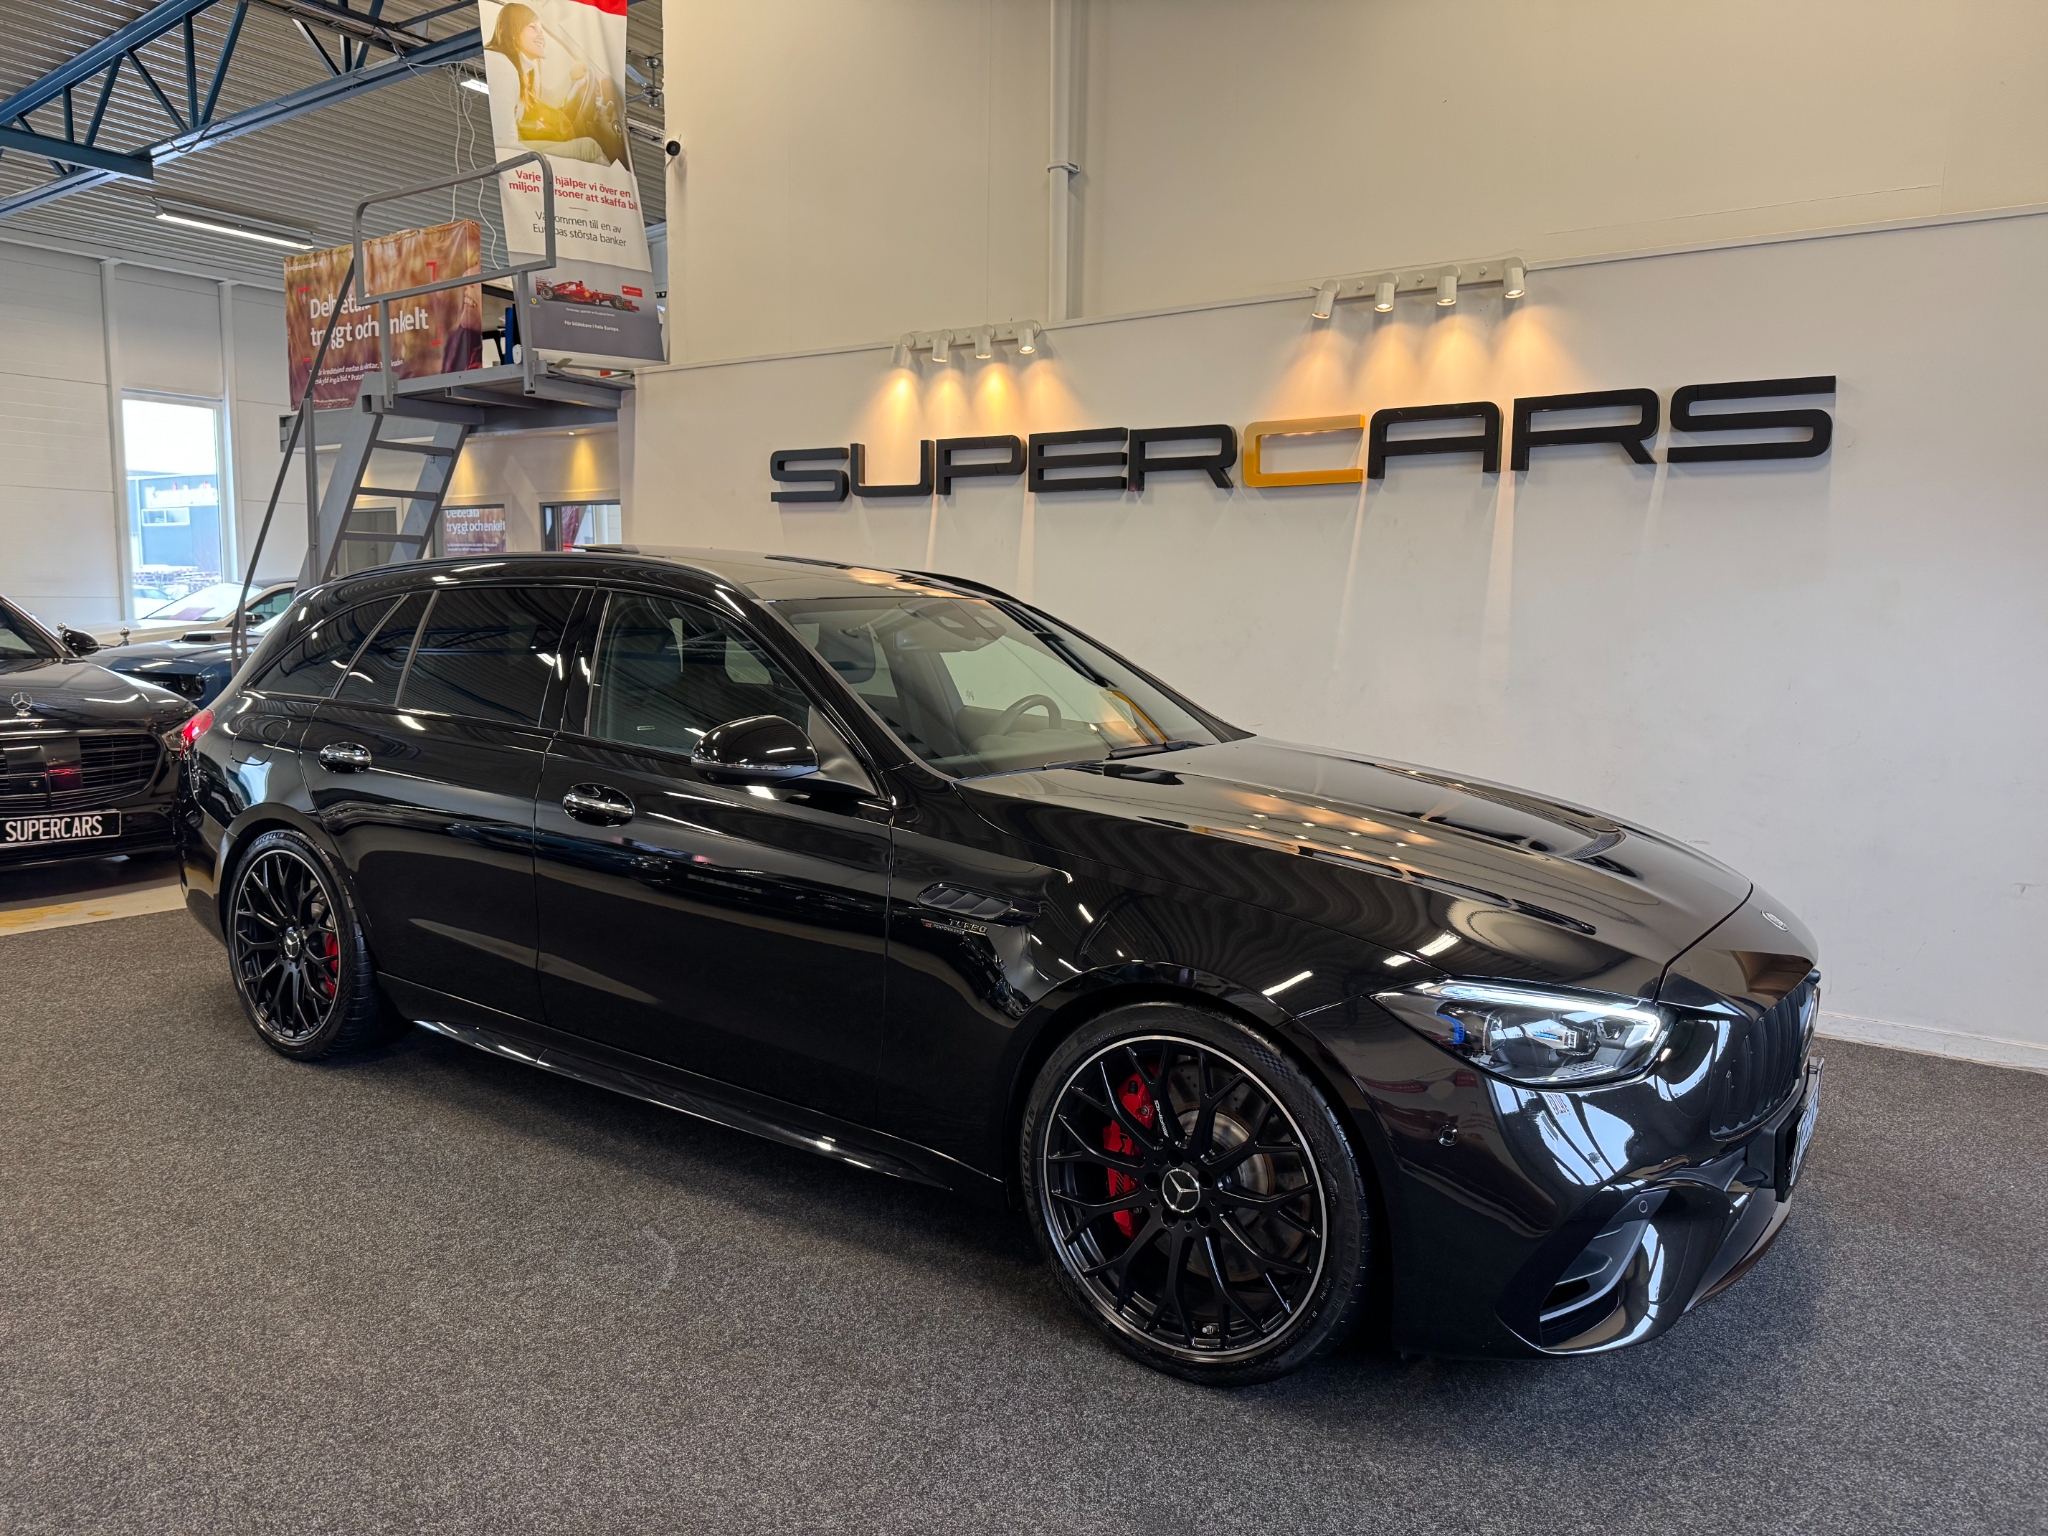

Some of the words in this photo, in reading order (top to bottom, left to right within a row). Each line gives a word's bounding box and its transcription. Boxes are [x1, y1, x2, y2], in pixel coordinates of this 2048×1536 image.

[509, 182, 540, 193] miljon
[543, 187, 584, 200] rsoner
[586, 194, 599, 203] att
[601, 196, 626, 209] skaffa
[515, 170, 541, 183] Varje
[555, 176, 587, 190] hjälper
[588, 182, 597, 190] vi
[599, 184, 617, 196] över
[620, 190, 631, 199] en
[533, 223, 568, 237] Eupas
[570, 229, 598, 242] största
[600, 233, 627, 247] banker
[535, 211, 588, 227] Väommen
[589, 218, 599, 230] till
[601, 222, 611, 232] en
[612, 225, 622, 234] av
[310, 322, 353, 350] trggt
[355, 314, 380, 340] och
[389, 306, 430, 335] nkelt
[771, 375, 1837, 502] SUPERCARS
[5, 815, 103, 842] SUPERCARS
[948, 918, 988, 933] TURBO
[1022, 1106, 1035, 1198] MICHELIN
